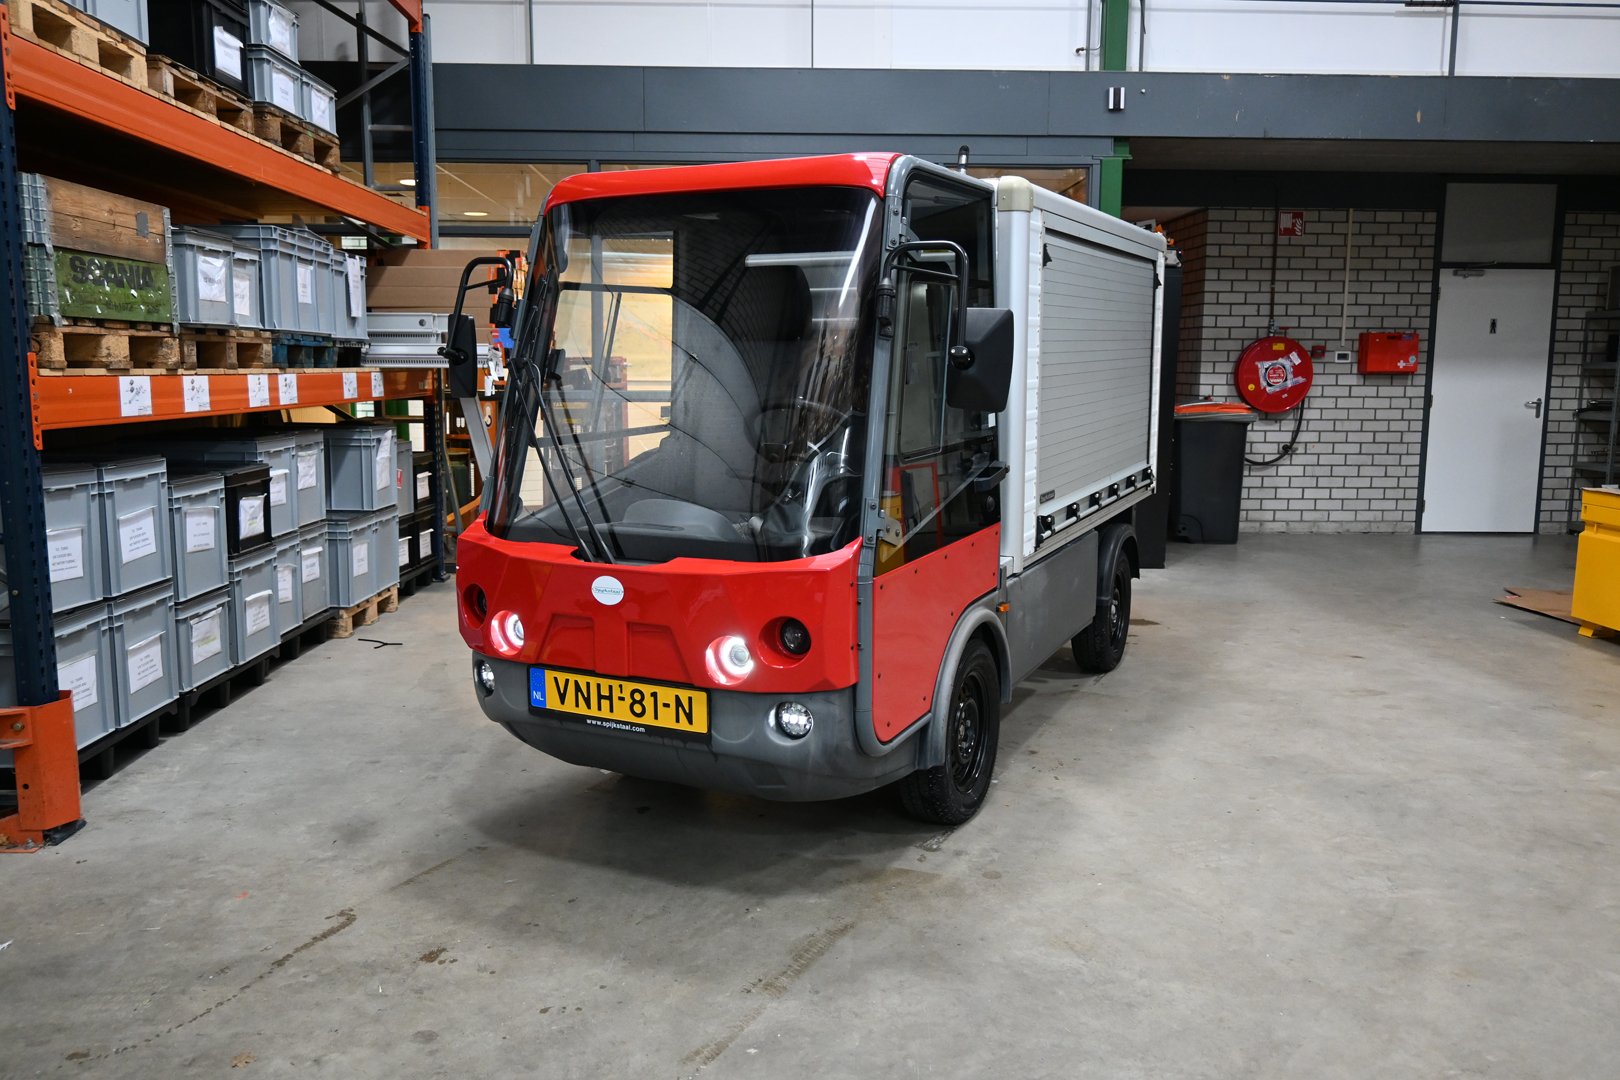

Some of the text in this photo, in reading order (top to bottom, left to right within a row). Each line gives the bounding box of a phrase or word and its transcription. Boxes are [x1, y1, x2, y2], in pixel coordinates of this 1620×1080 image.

[70, 255, 154, 290] SCANIA
[533, 676, 693, 725] NL VNH-81-N
[586, 718, 646, 733] www.spijkstaal.com
